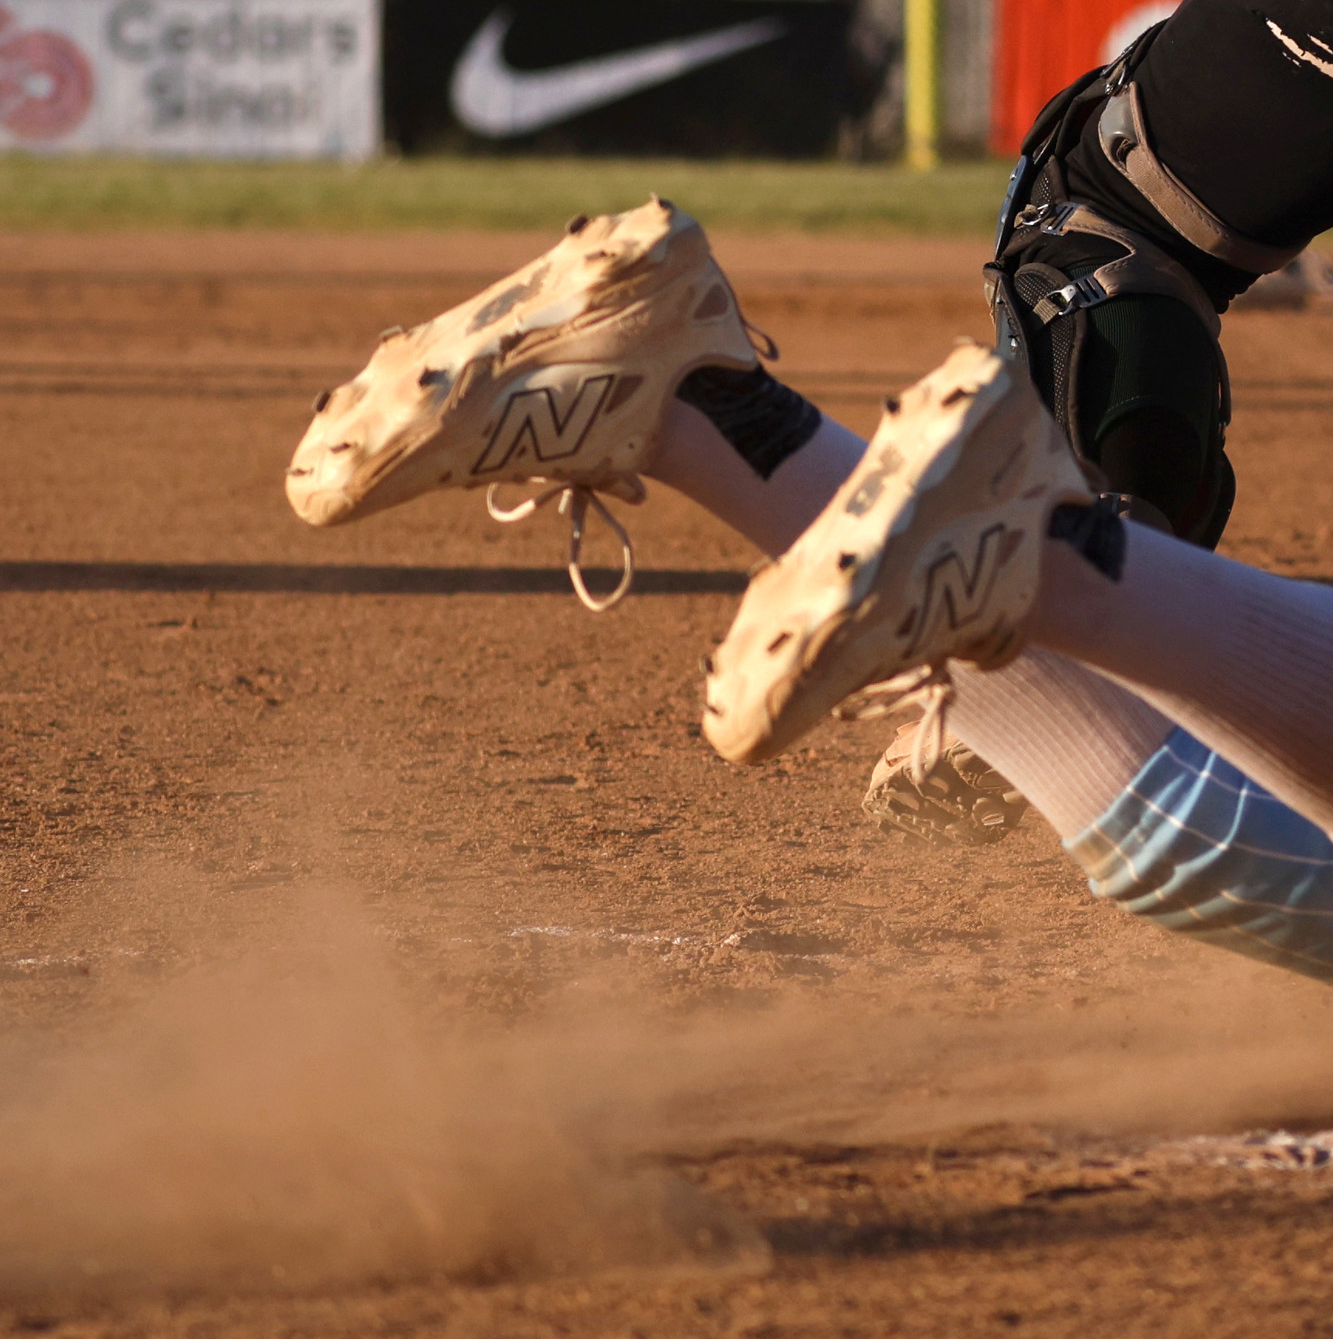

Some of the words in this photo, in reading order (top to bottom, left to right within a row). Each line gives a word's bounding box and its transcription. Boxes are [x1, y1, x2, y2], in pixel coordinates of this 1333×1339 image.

[146, 65, 322, 131] Sinai
[468, 372, 618, 476] N
[899, 522, 1006, 662] N
